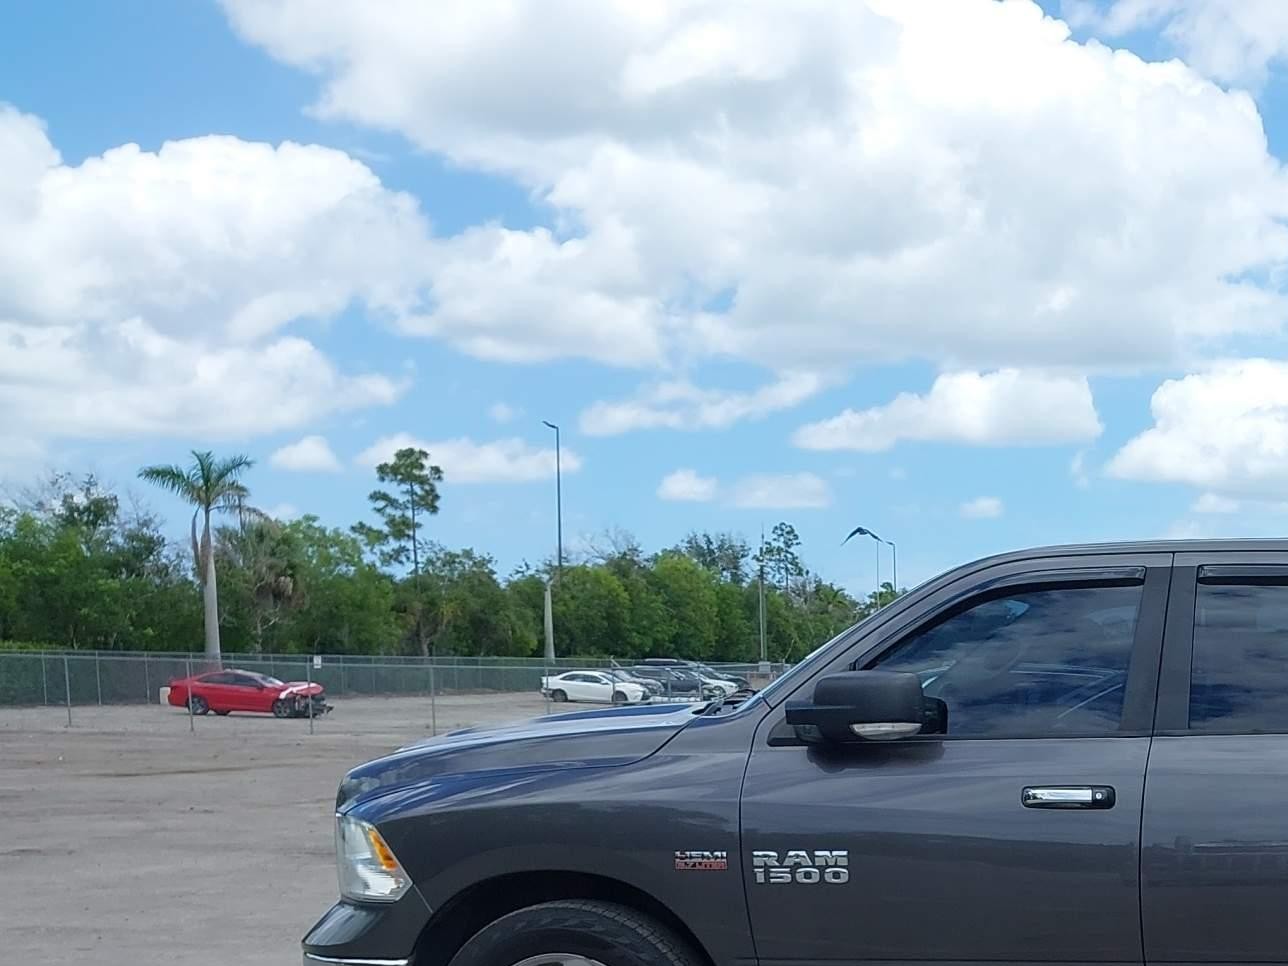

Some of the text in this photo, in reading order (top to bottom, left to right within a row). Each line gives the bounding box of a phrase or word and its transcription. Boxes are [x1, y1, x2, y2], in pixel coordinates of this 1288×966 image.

[674, 850, 727, 862] HEMI
[752, 850, 849, 866] RAM
[752, 867, 849, 884] 1500
